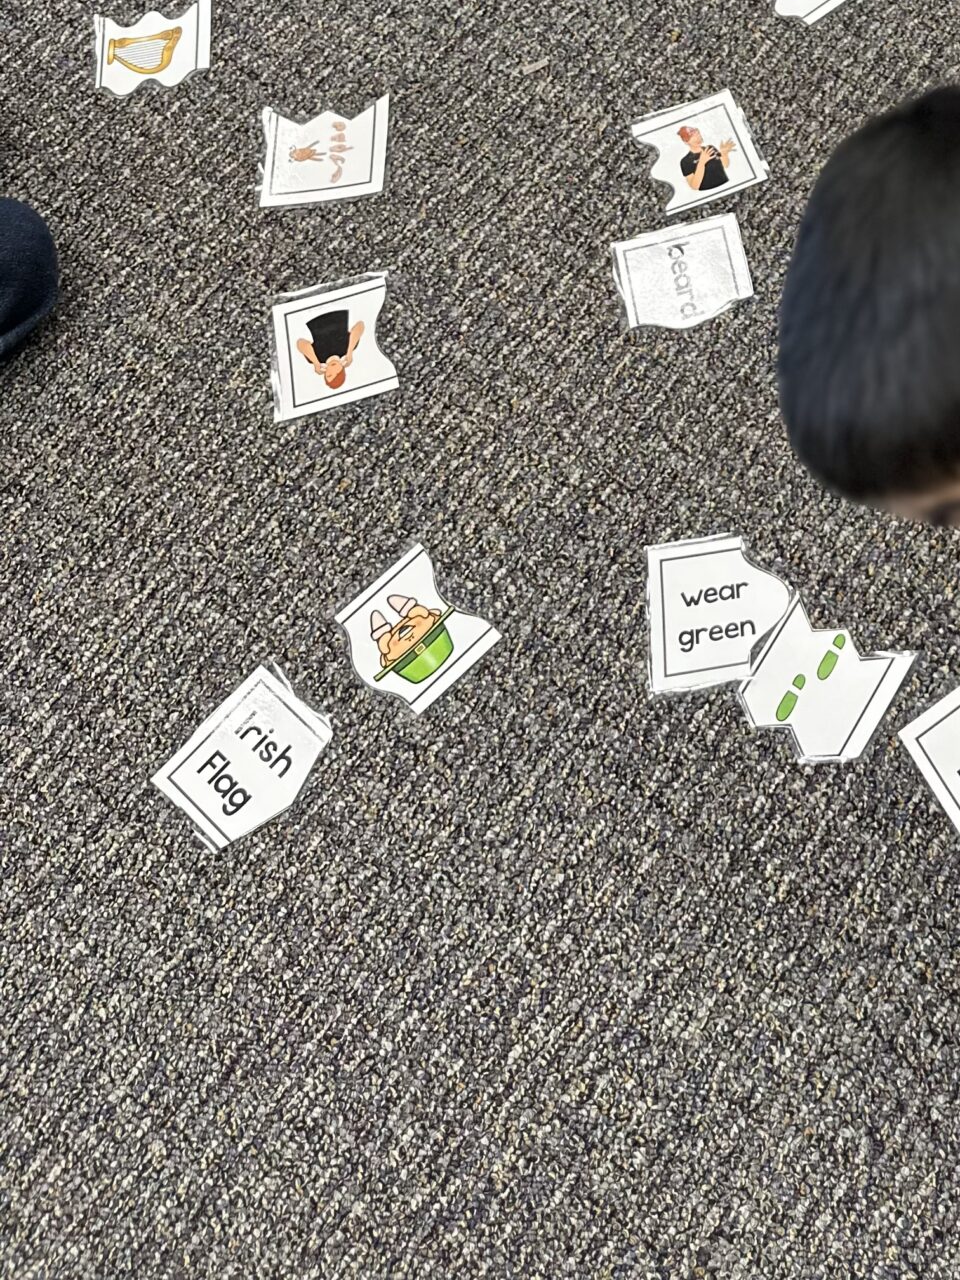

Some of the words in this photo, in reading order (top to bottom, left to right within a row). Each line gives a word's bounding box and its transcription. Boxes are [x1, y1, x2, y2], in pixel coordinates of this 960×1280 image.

[666, 241, 705, 320] beard
[680, 578, 749, 608] wear
[678, 618, 756, 653] green
[234, 710, 293, 779] Irish
[196, 749, 253, 817] Flag
